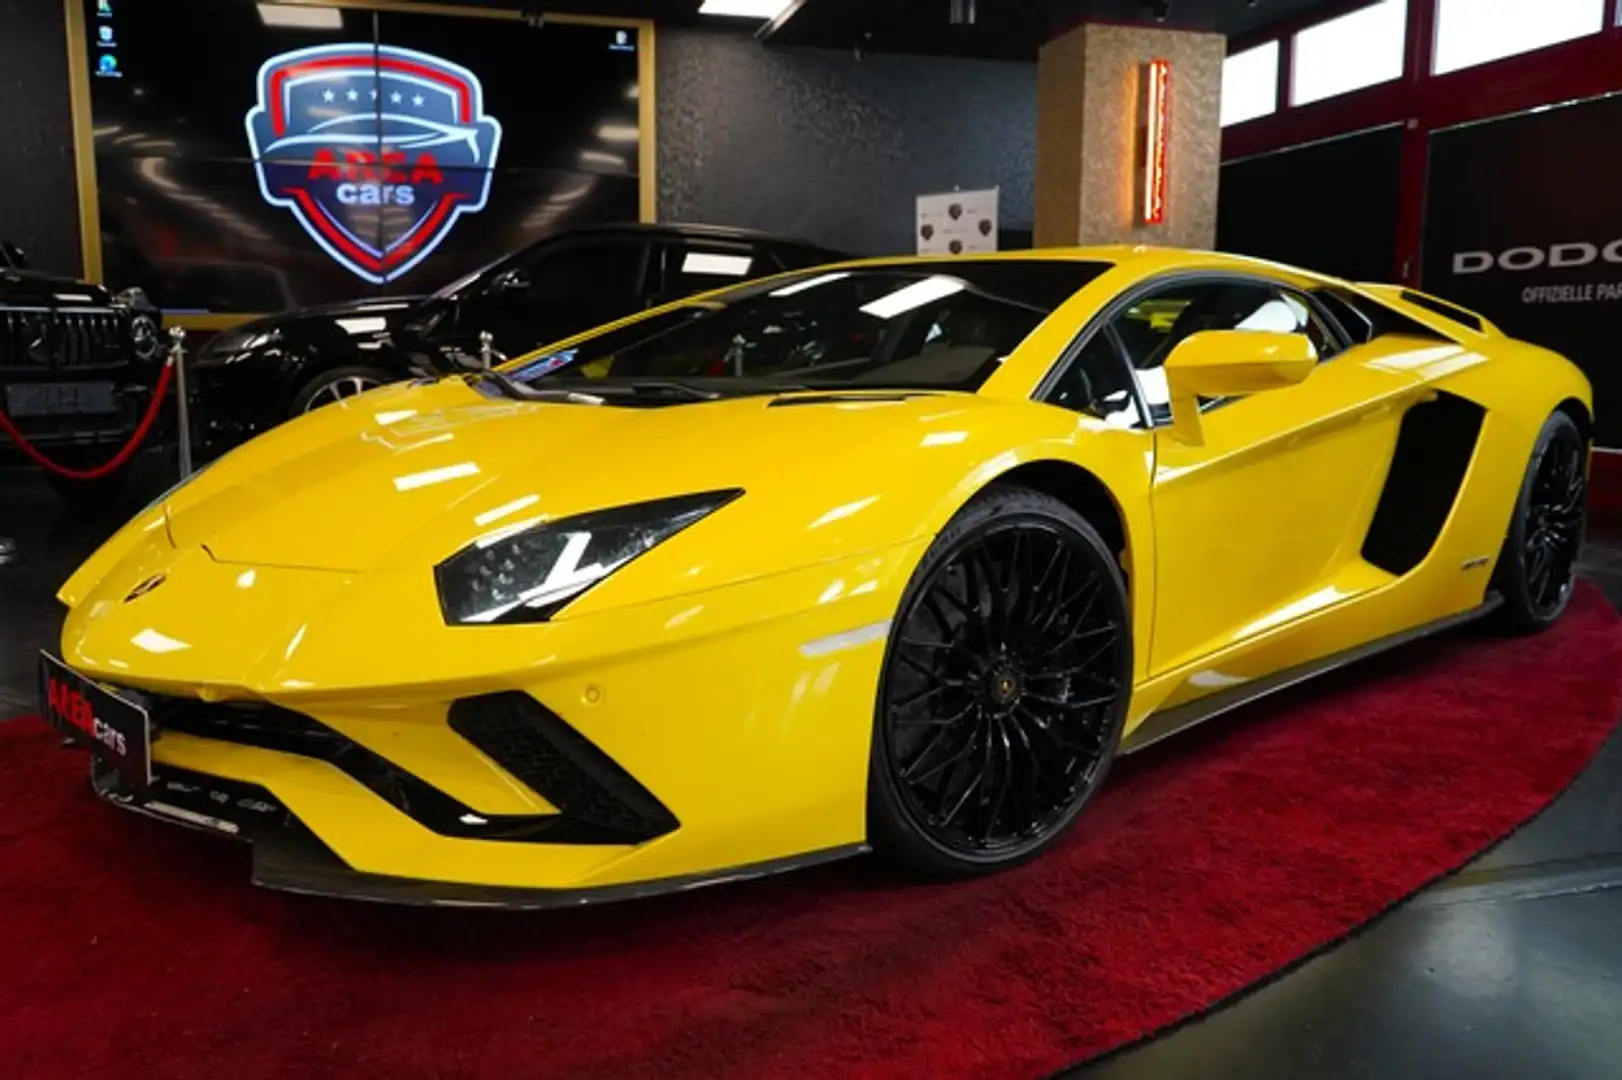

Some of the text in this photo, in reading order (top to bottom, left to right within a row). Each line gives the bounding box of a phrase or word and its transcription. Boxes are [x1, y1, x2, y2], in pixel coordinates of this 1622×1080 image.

[307, 147, 444, 184] AREA
[336, 183, 415, 205] cars
[1522, 284, 1594, 303] OFFIZIELLE
